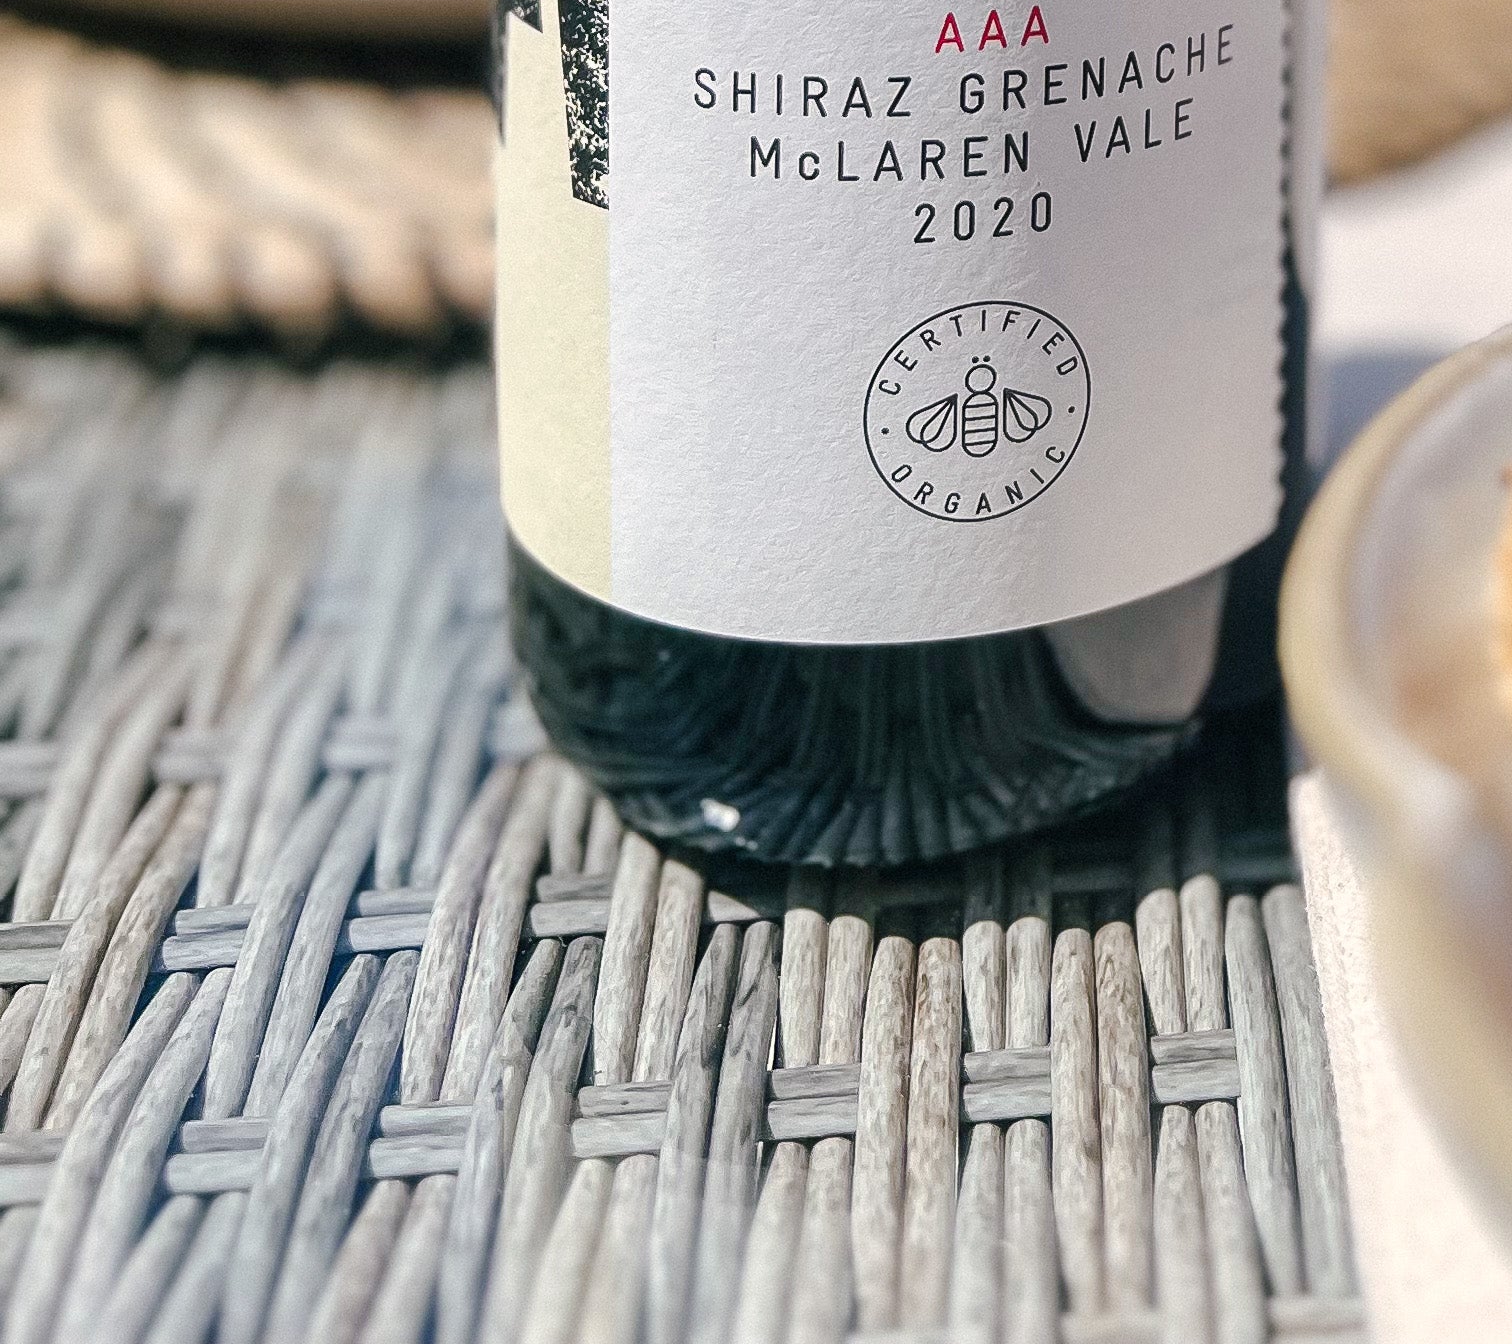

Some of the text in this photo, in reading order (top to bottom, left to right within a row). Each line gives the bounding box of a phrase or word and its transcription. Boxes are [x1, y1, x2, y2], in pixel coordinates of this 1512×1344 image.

[934, 4, 1050, 54] AAA
[693, 23, 1235, 118] SHIRAZ GRENACHE
[749, 97, 1194, 182] McLAREN VALE
[913, 191, 1053, 244] 2020
[878, 308, 1079, 396] CERTIFIED
[891, 445, 1066, 515] ORGANIC
